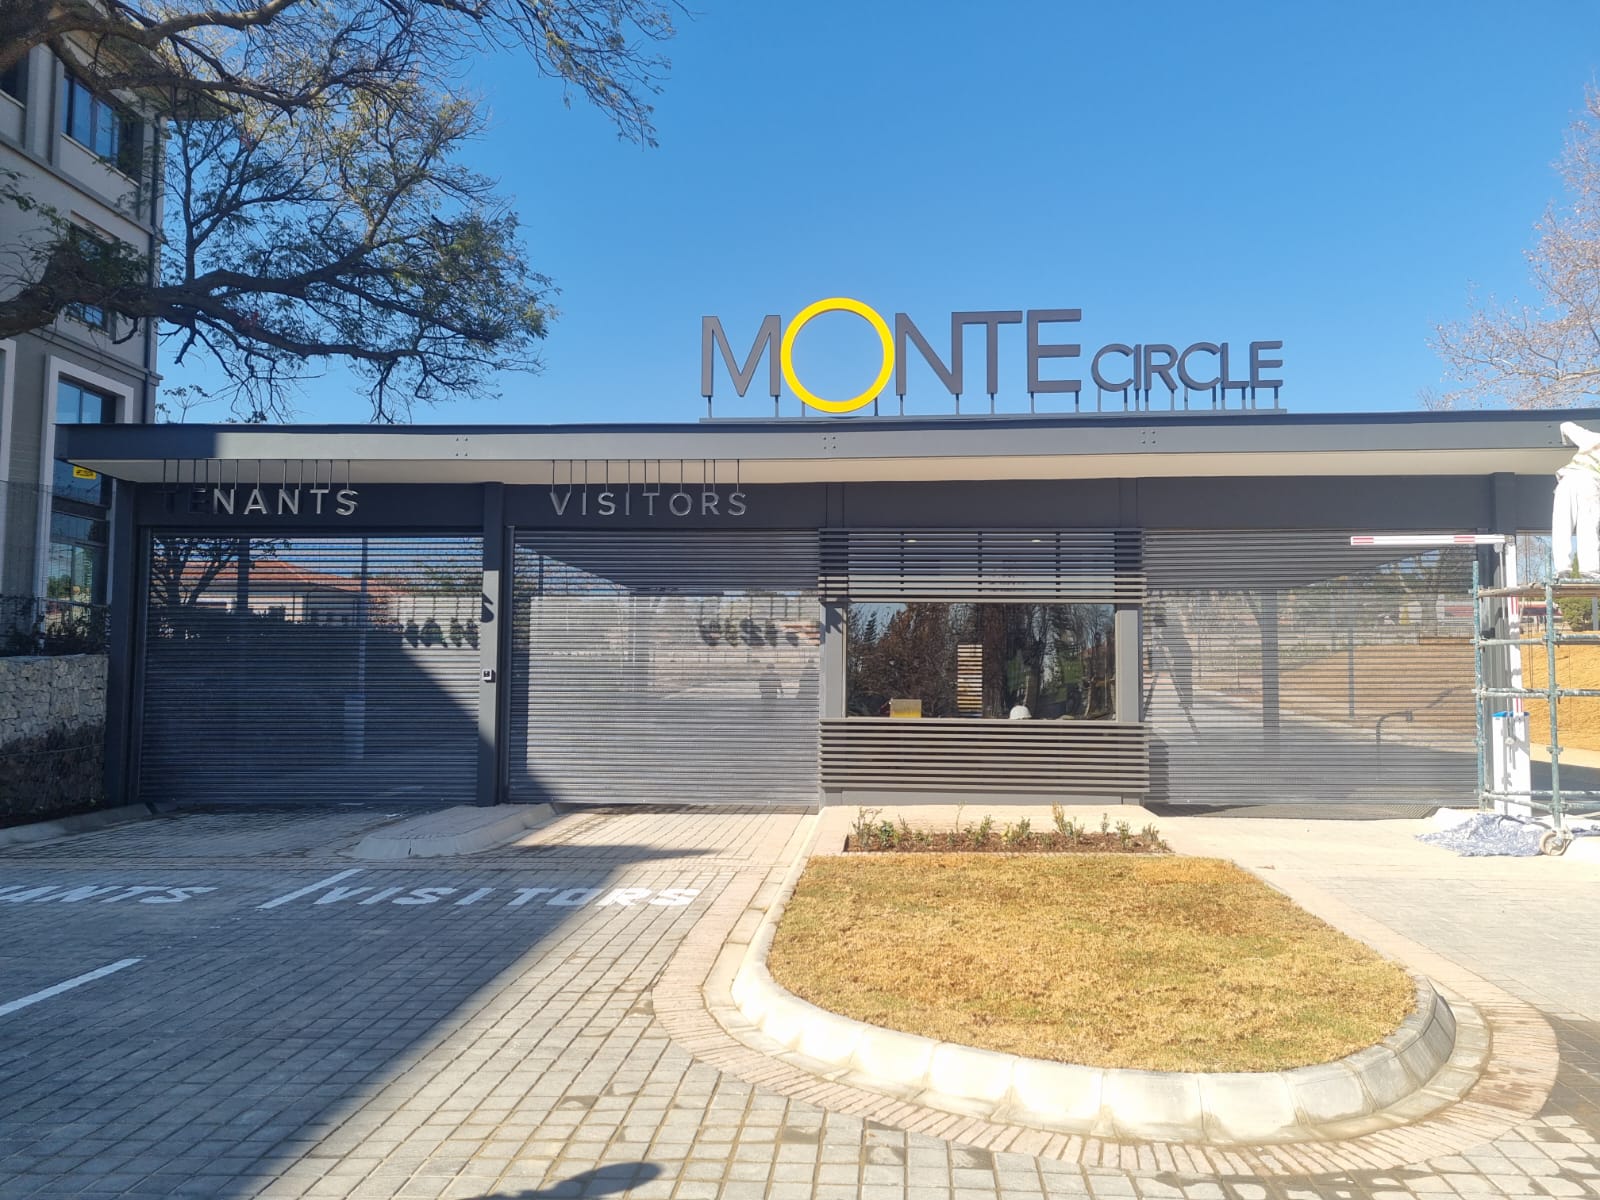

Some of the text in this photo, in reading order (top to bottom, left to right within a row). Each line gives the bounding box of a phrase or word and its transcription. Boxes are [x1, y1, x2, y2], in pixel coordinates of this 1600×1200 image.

[701, 297, 1283, 413] MONTE CIRCLE
[550, 492, 747, 516] VISITORS
[312, 887, 700, 906] VISITORS
